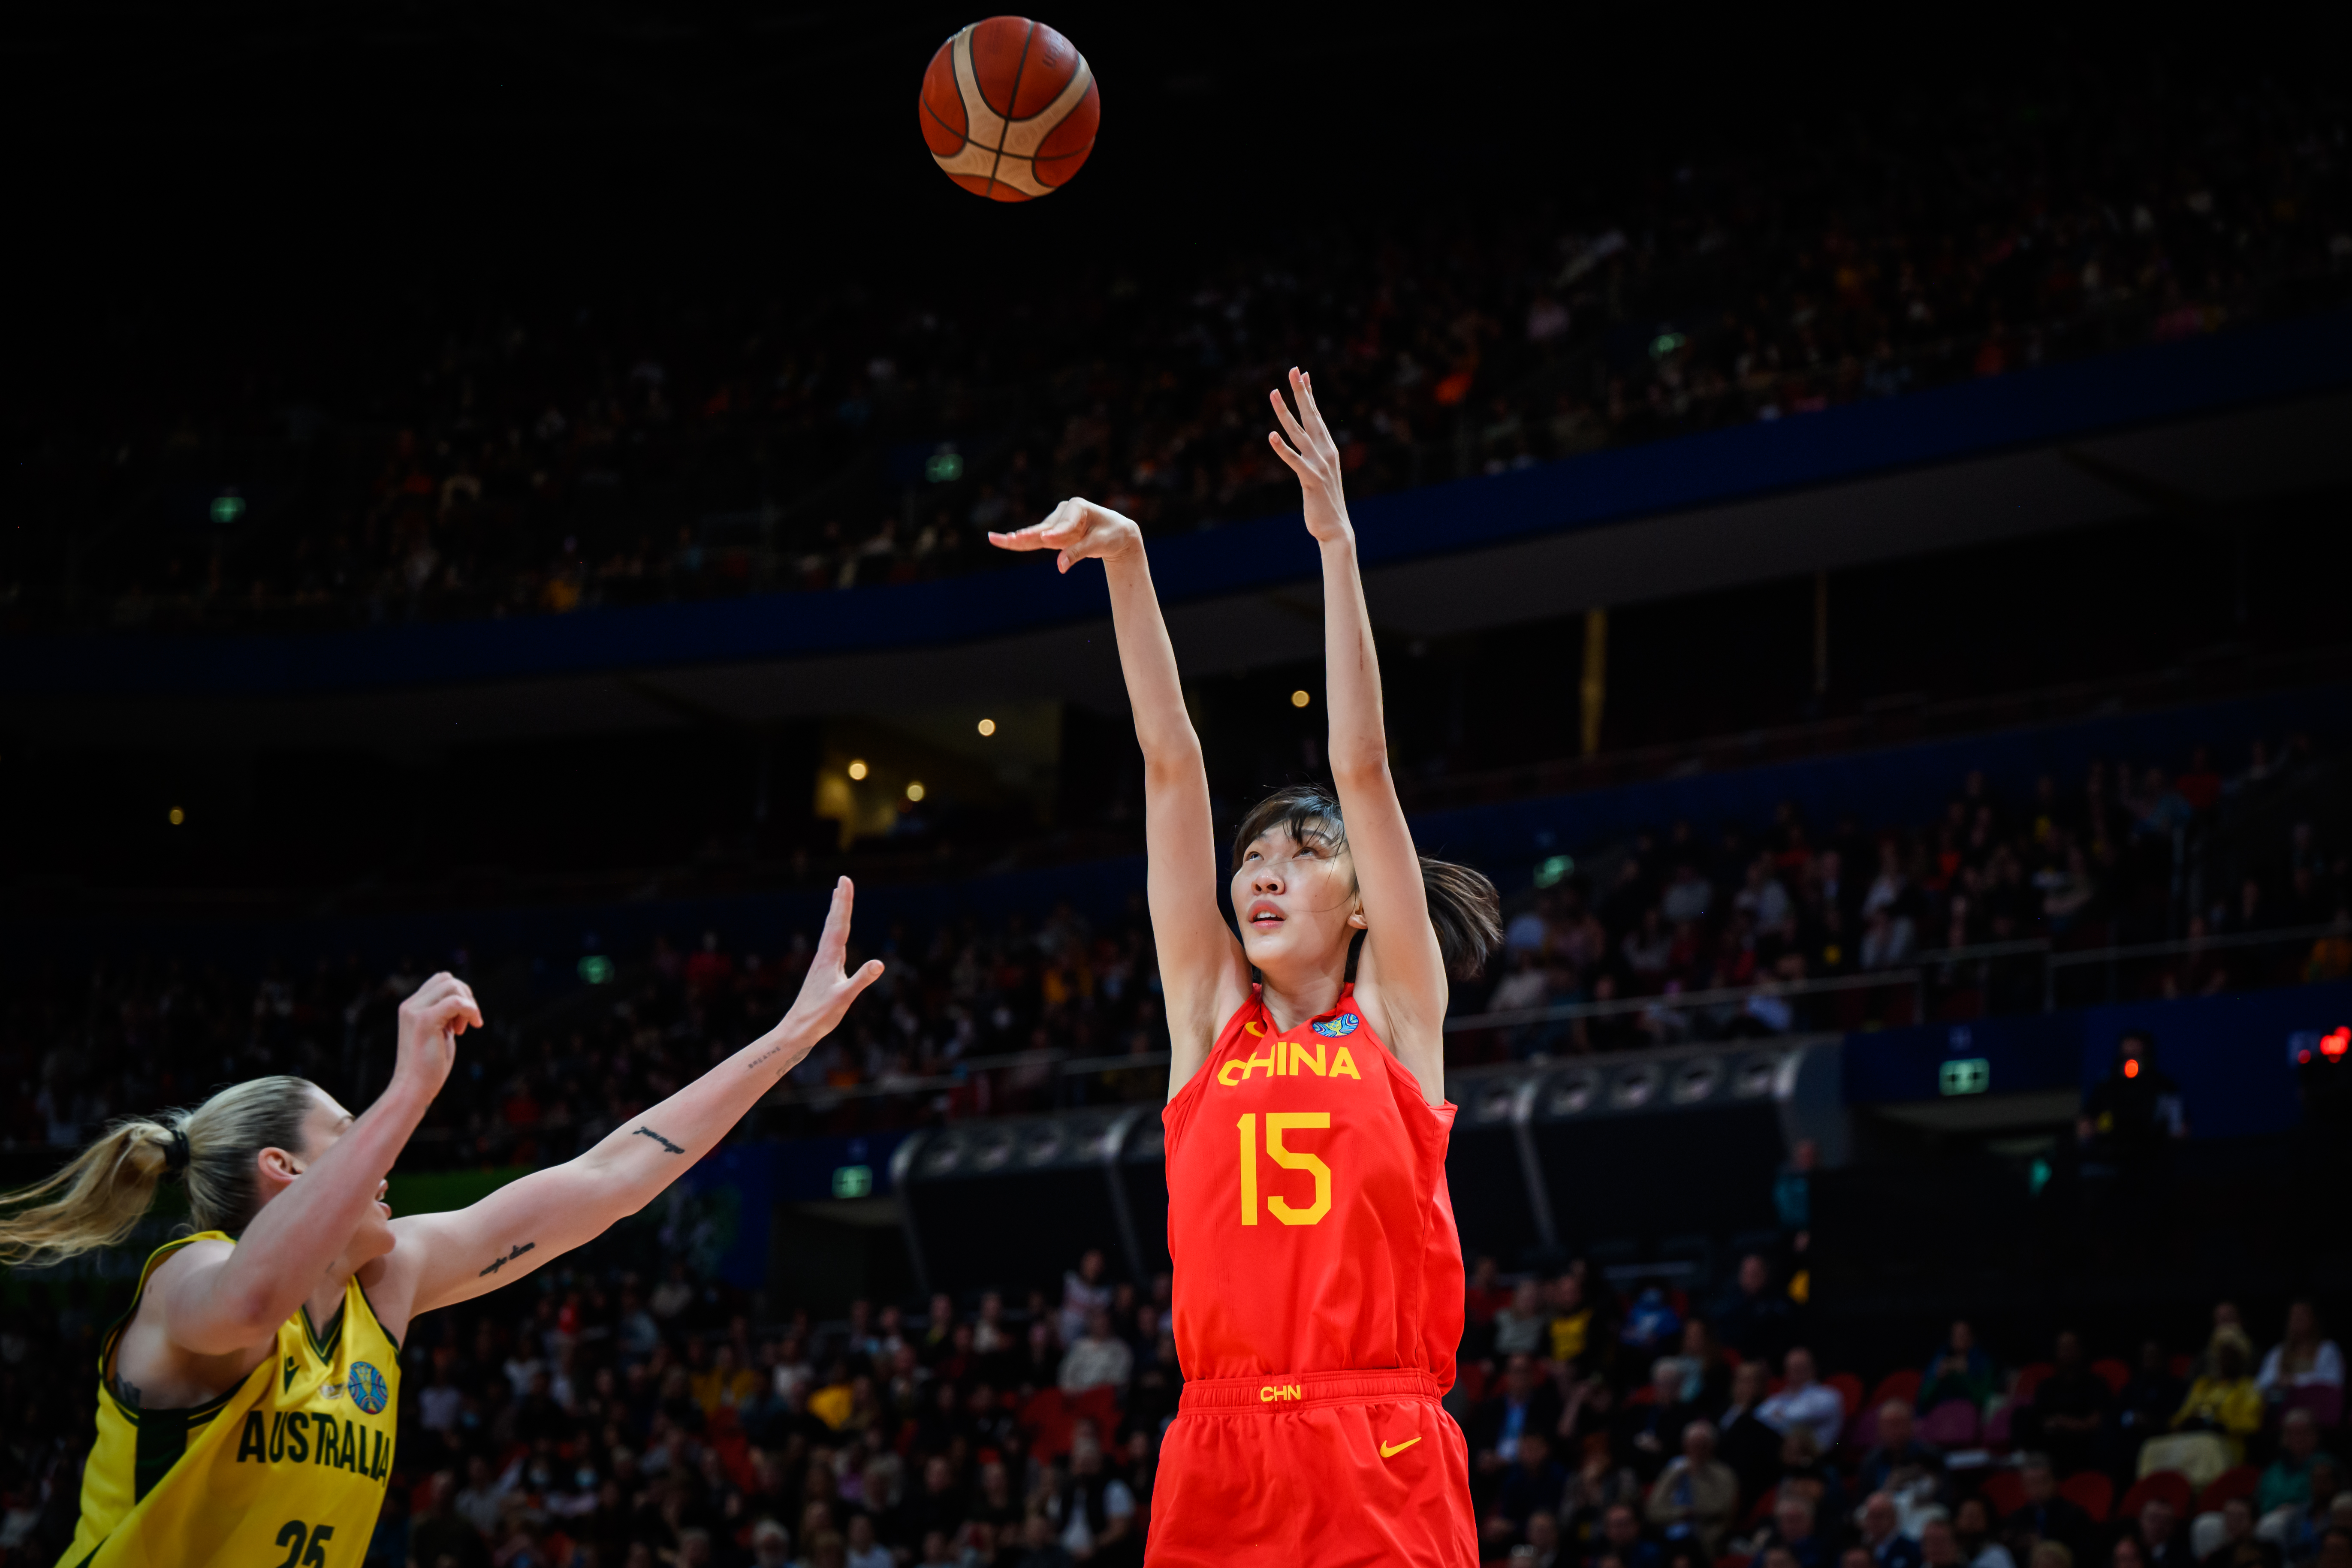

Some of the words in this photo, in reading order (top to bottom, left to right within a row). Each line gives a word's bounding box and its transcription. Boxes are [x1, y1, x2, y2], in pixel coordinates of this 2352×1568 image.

[748, 1046, 781, 1069] BREATHE
[1217, 1041, 1361, 1086] CHINA
[1236, 1112, 1331, 1225] 15
[1260, 1384, 1301, 1402] CHN
[237, 1411, 390, 1487] AUSTRALIA
[275, 1520, 335, 1568] 25
